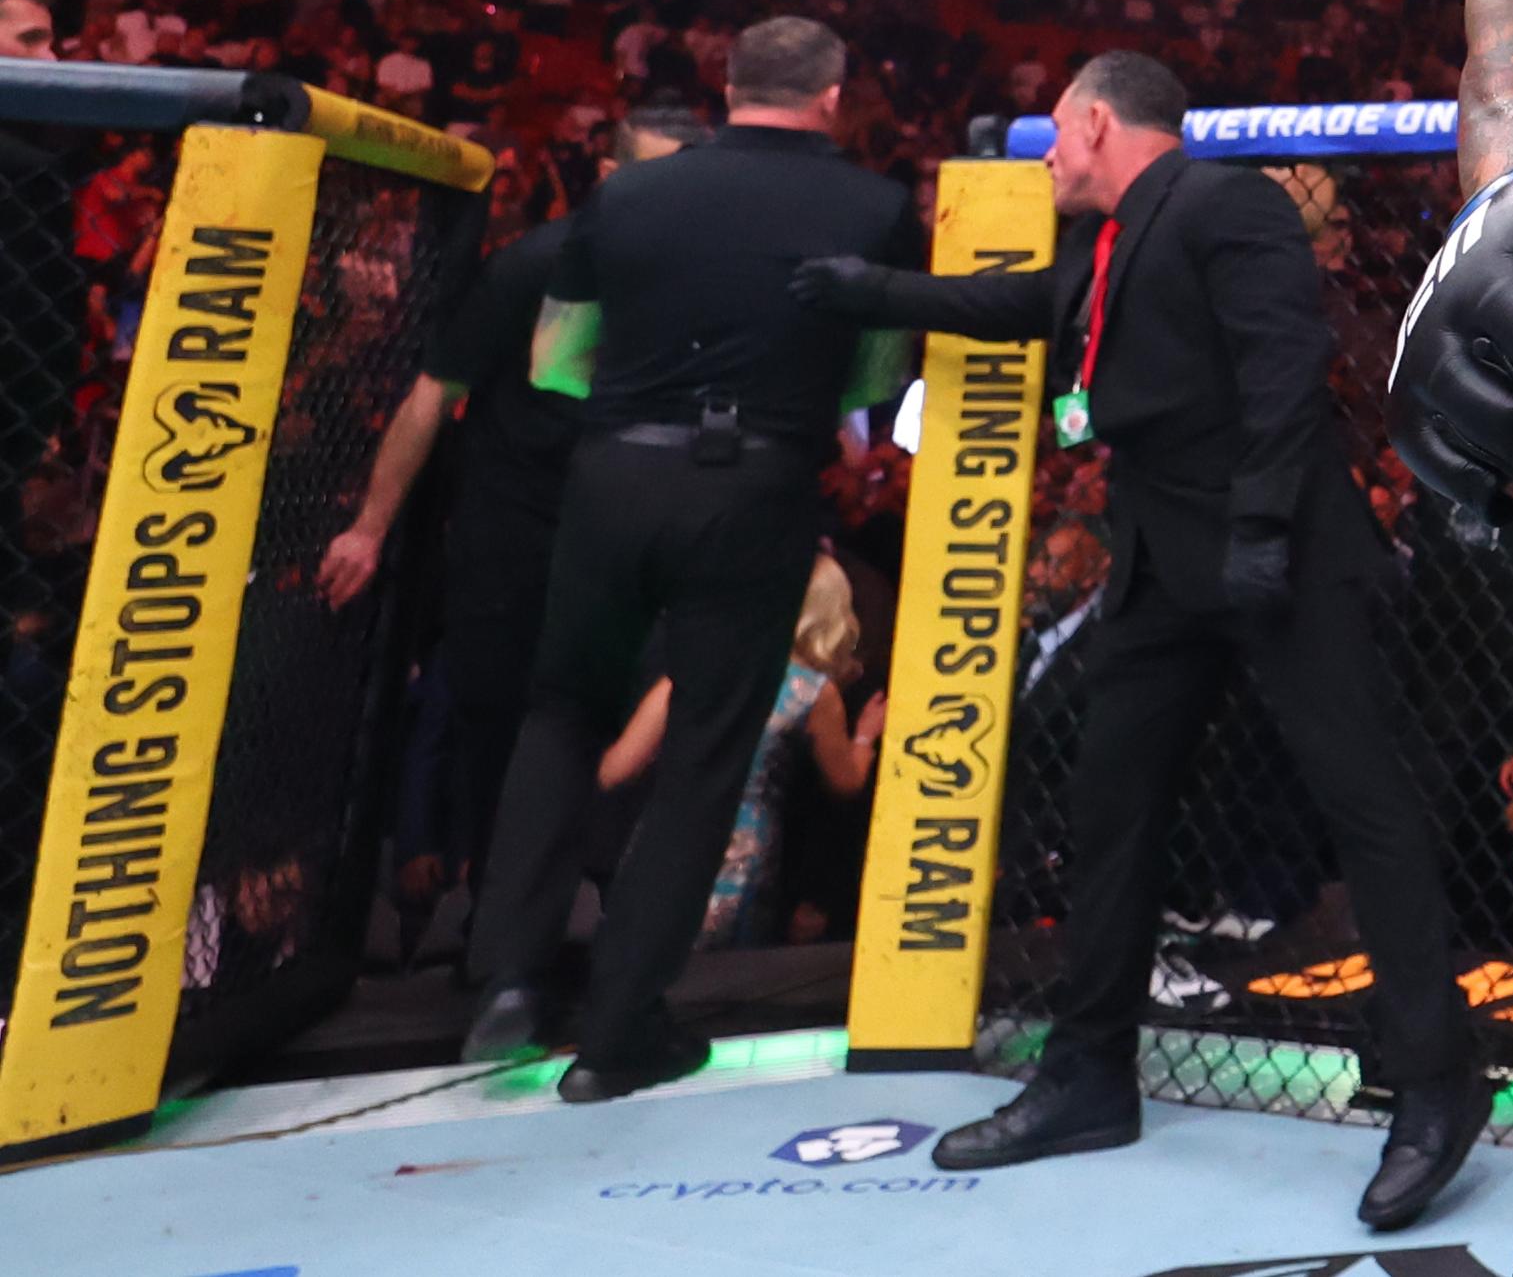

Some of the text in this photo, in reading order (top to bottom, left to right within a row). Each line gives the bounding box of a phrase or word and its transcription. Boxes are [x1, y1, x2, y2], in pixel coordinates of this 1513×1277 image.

[1394, 100, 1458, 135] ON
[50, 226, 275, 1030] NOTHING STOPS RAM
[898, 249, 1037, 953] NHING STOPS RAM
[599, 1175, 983, 1202] crypto.com
